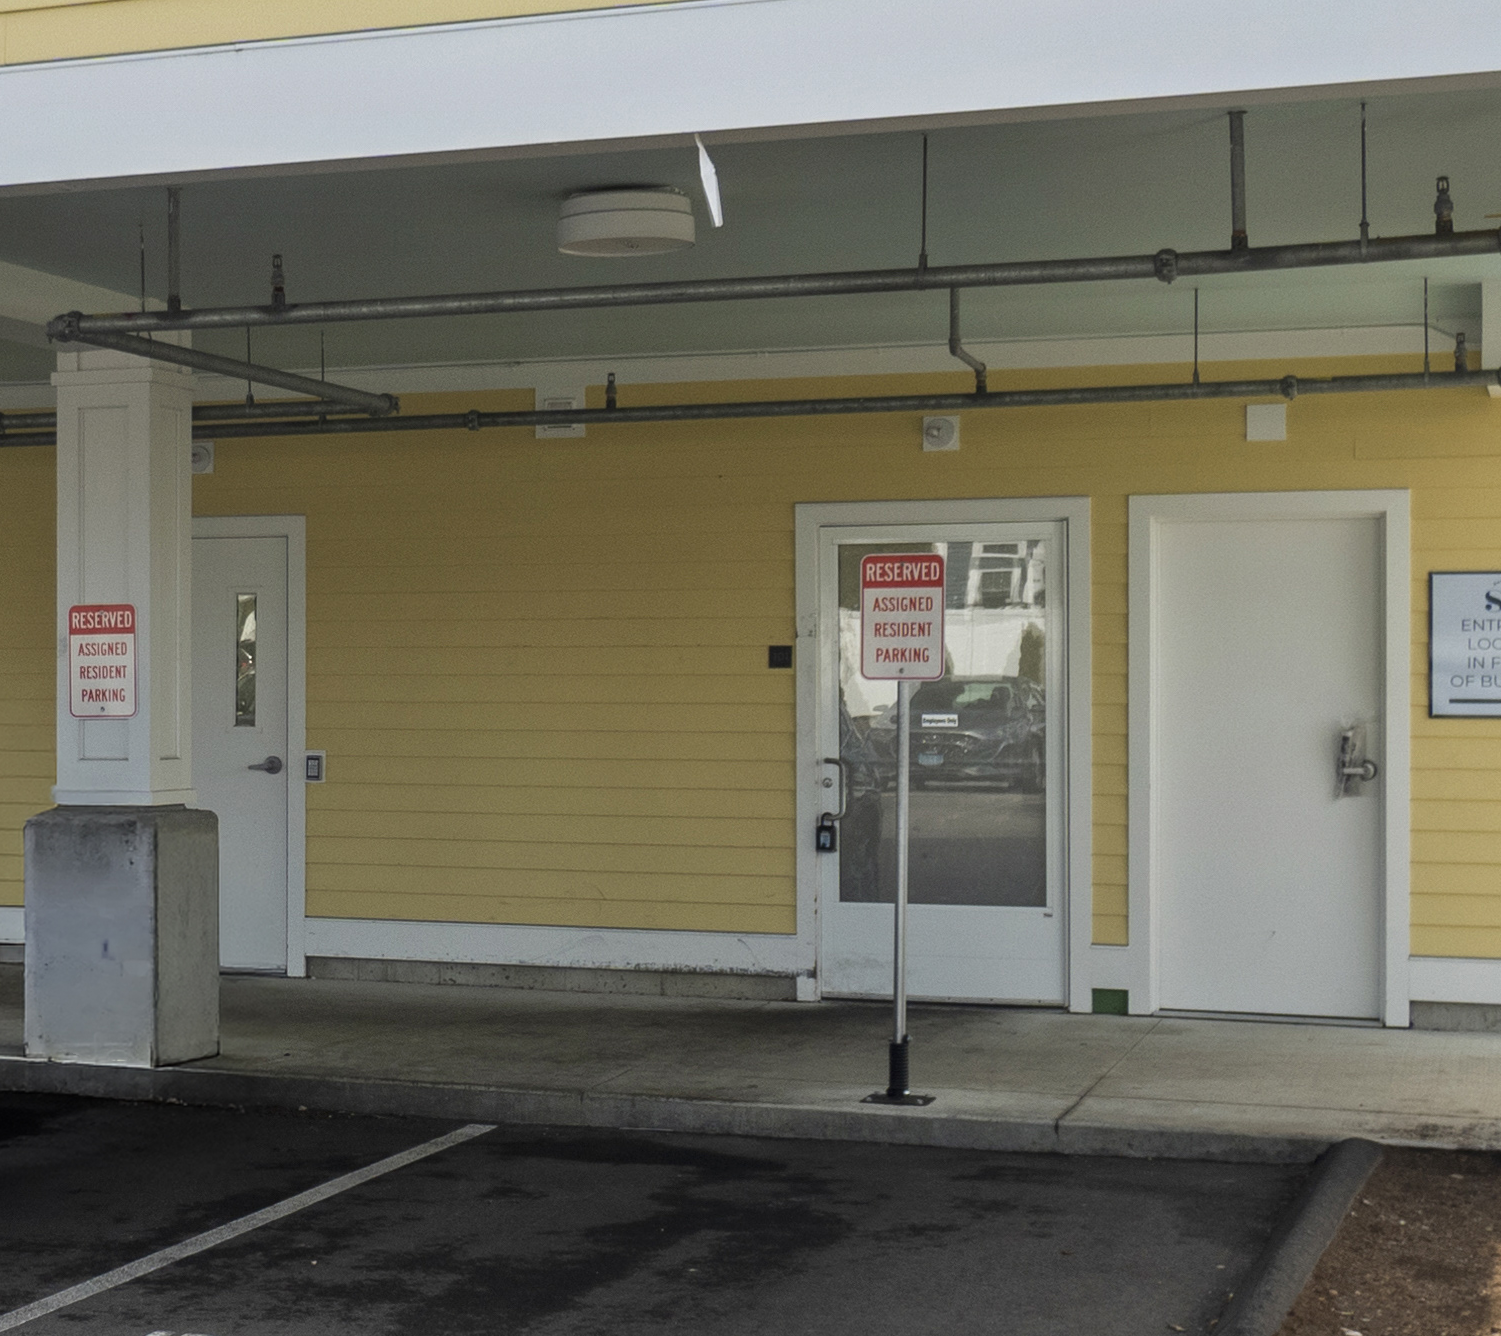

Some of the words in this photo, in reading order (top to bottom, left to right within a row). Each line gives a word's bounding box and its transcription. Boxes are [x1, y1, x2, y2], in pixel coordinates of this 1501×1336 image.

[866, 562, 940, 581] RESERVED
[873, 597, 933, 612] ASSIGNED
[72, 611, 132, 629] RESERVED
[874, 622, 932, 638] RESIDENT
[78, 642, 128, 656] ASSIGNED
[876, 648, 930, 663] PARKING
[1467, 656, 1485, 670] IN
[79, 665, 127, 679] RESIDENT
[1450, 675, 1475, 688] OF
[81, 688, 126, 703] PARKING
